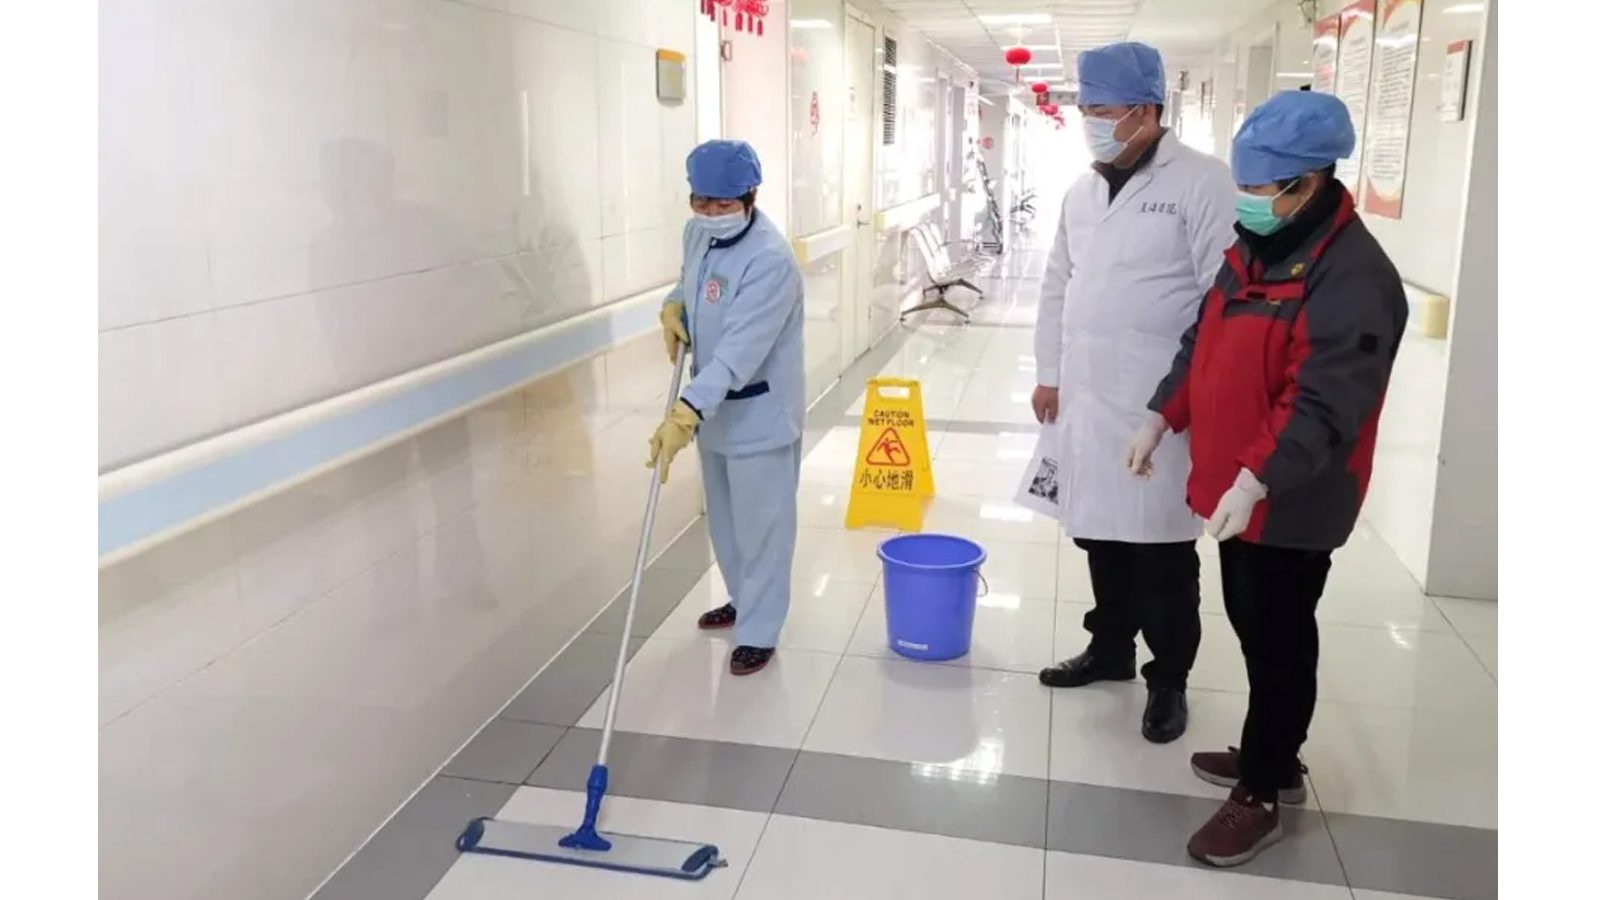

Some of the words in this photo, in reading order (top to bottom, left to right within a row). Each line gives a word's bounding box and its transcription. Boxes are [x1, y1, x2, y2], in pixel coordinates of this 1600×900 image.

[874, 409, 910, 419] CAUTION
[859, 468, 914, 491] 小心地滑
